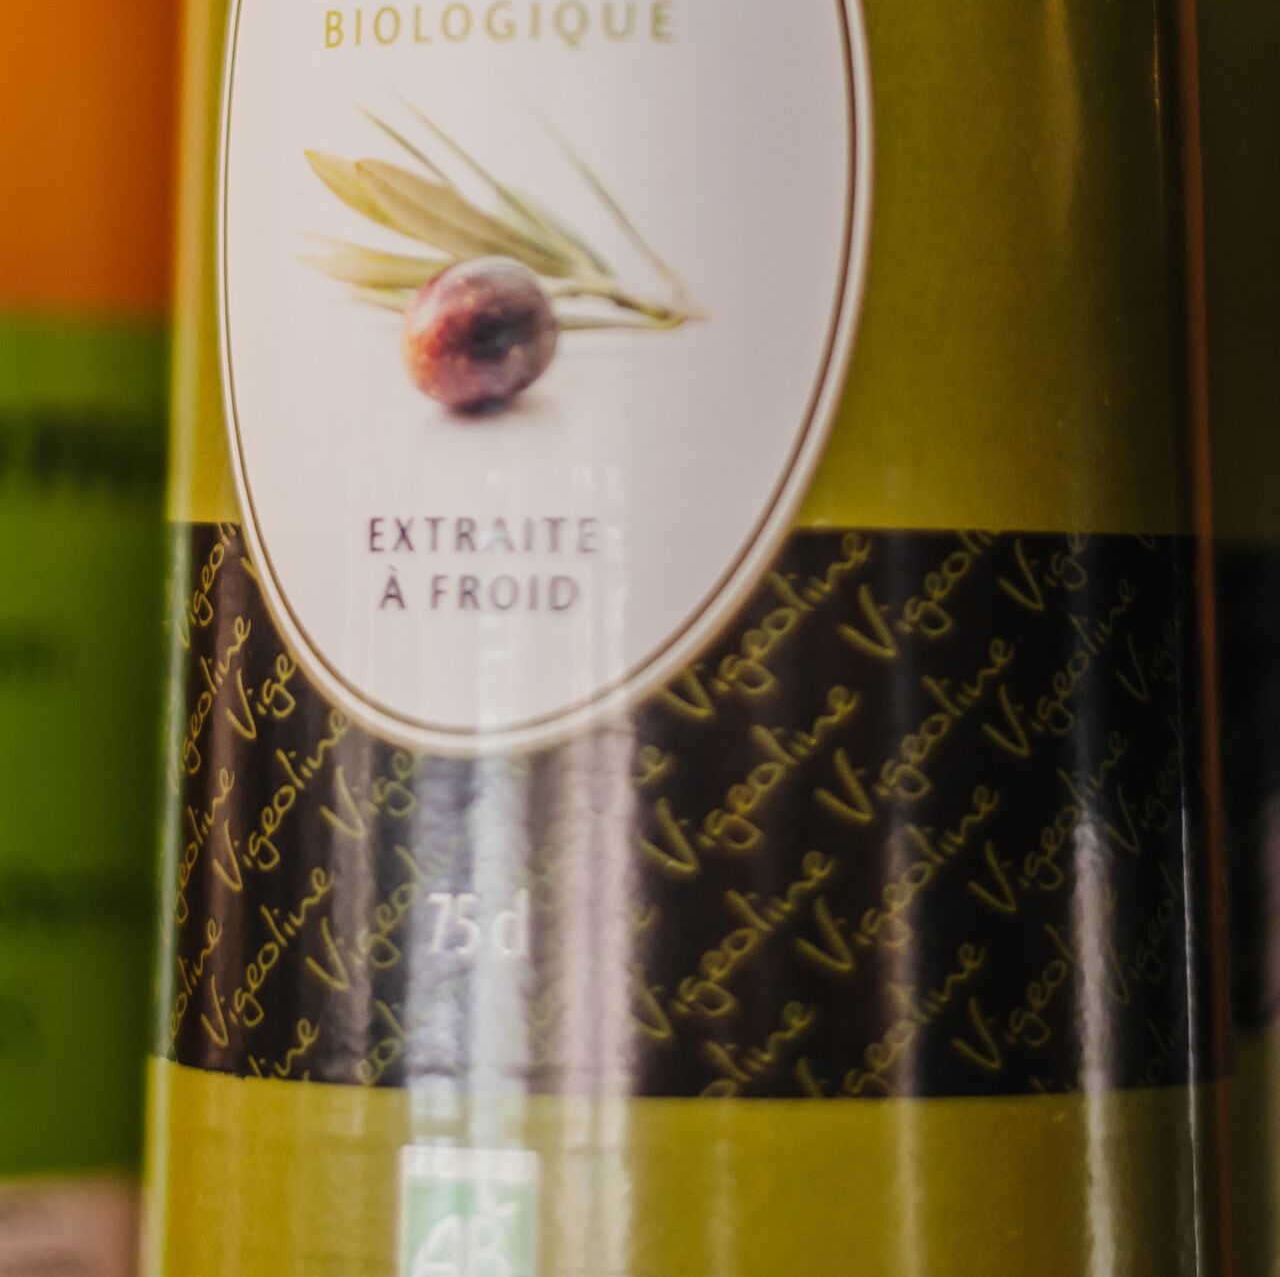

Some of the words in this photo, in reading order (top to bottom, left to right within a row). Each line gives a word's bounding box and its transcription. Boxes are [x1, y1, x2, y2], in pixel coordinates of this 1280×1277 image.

[324, 0, 677, 51] BIOLOGIQUE
[368, 516, 600, 554] EXTRAITE
[378, 564, 407, 611] À
[429, 574, 581, 612] FROID
[426, 892, 481, 956] 75
[201, 866, 335, 1047] Vigeoline
